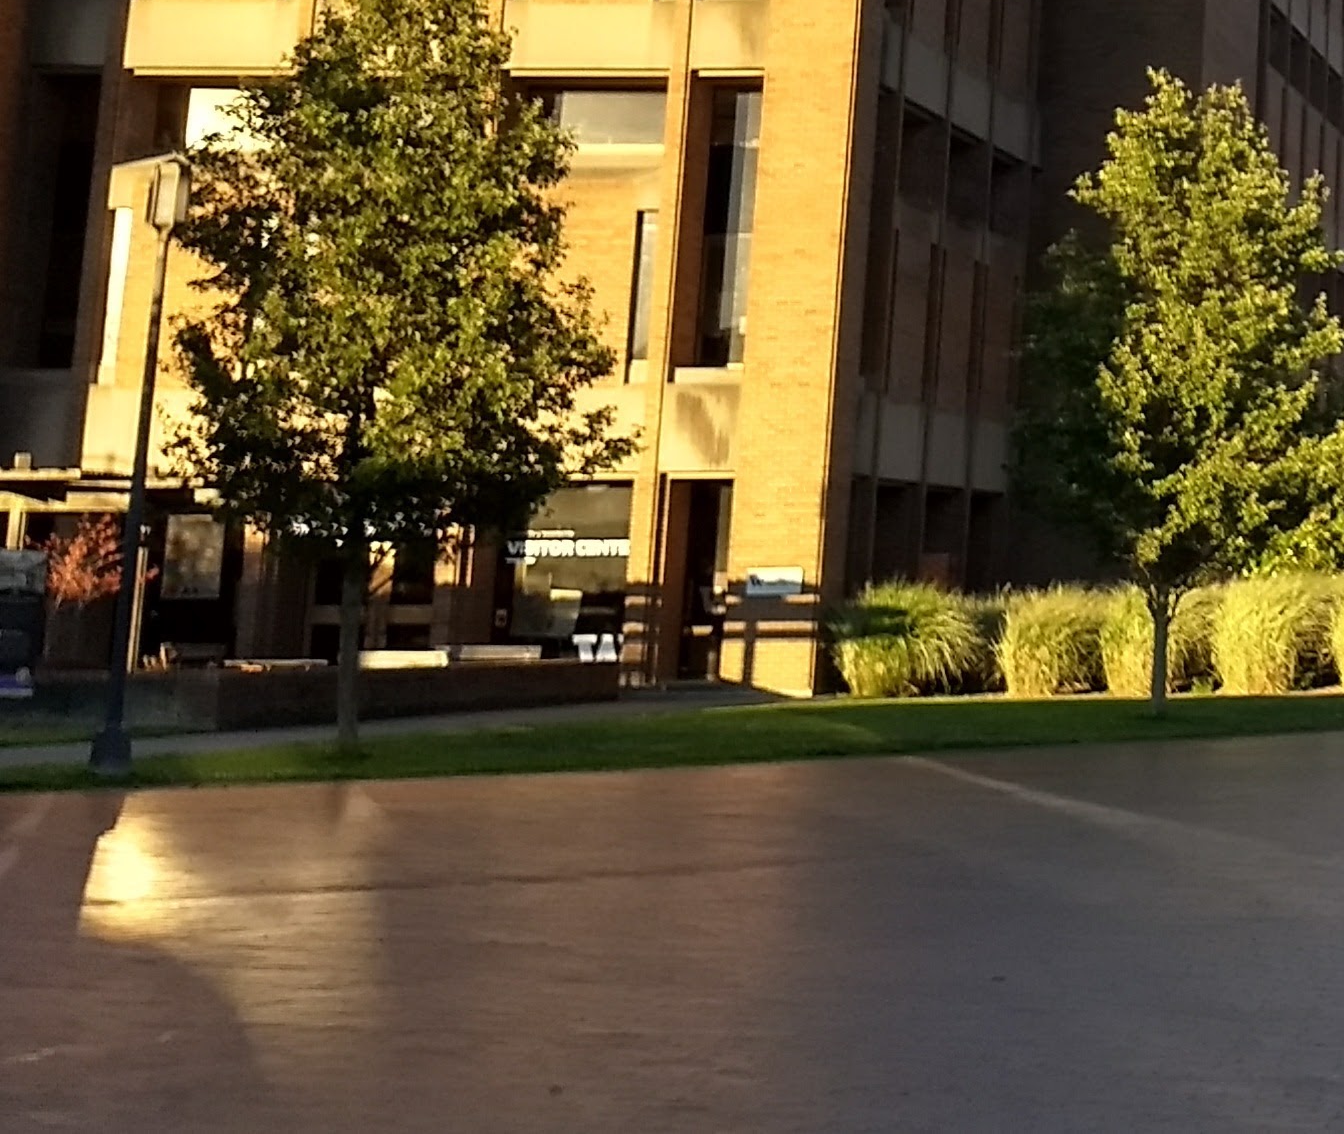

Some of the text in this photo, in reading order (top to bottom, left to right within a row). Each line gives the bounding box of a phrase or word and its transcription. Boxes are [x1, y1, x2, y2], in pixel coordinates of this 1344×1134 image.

[507, 539, 631, 556] VISITOR CENTE
[572, 634, 624, 663] TA
